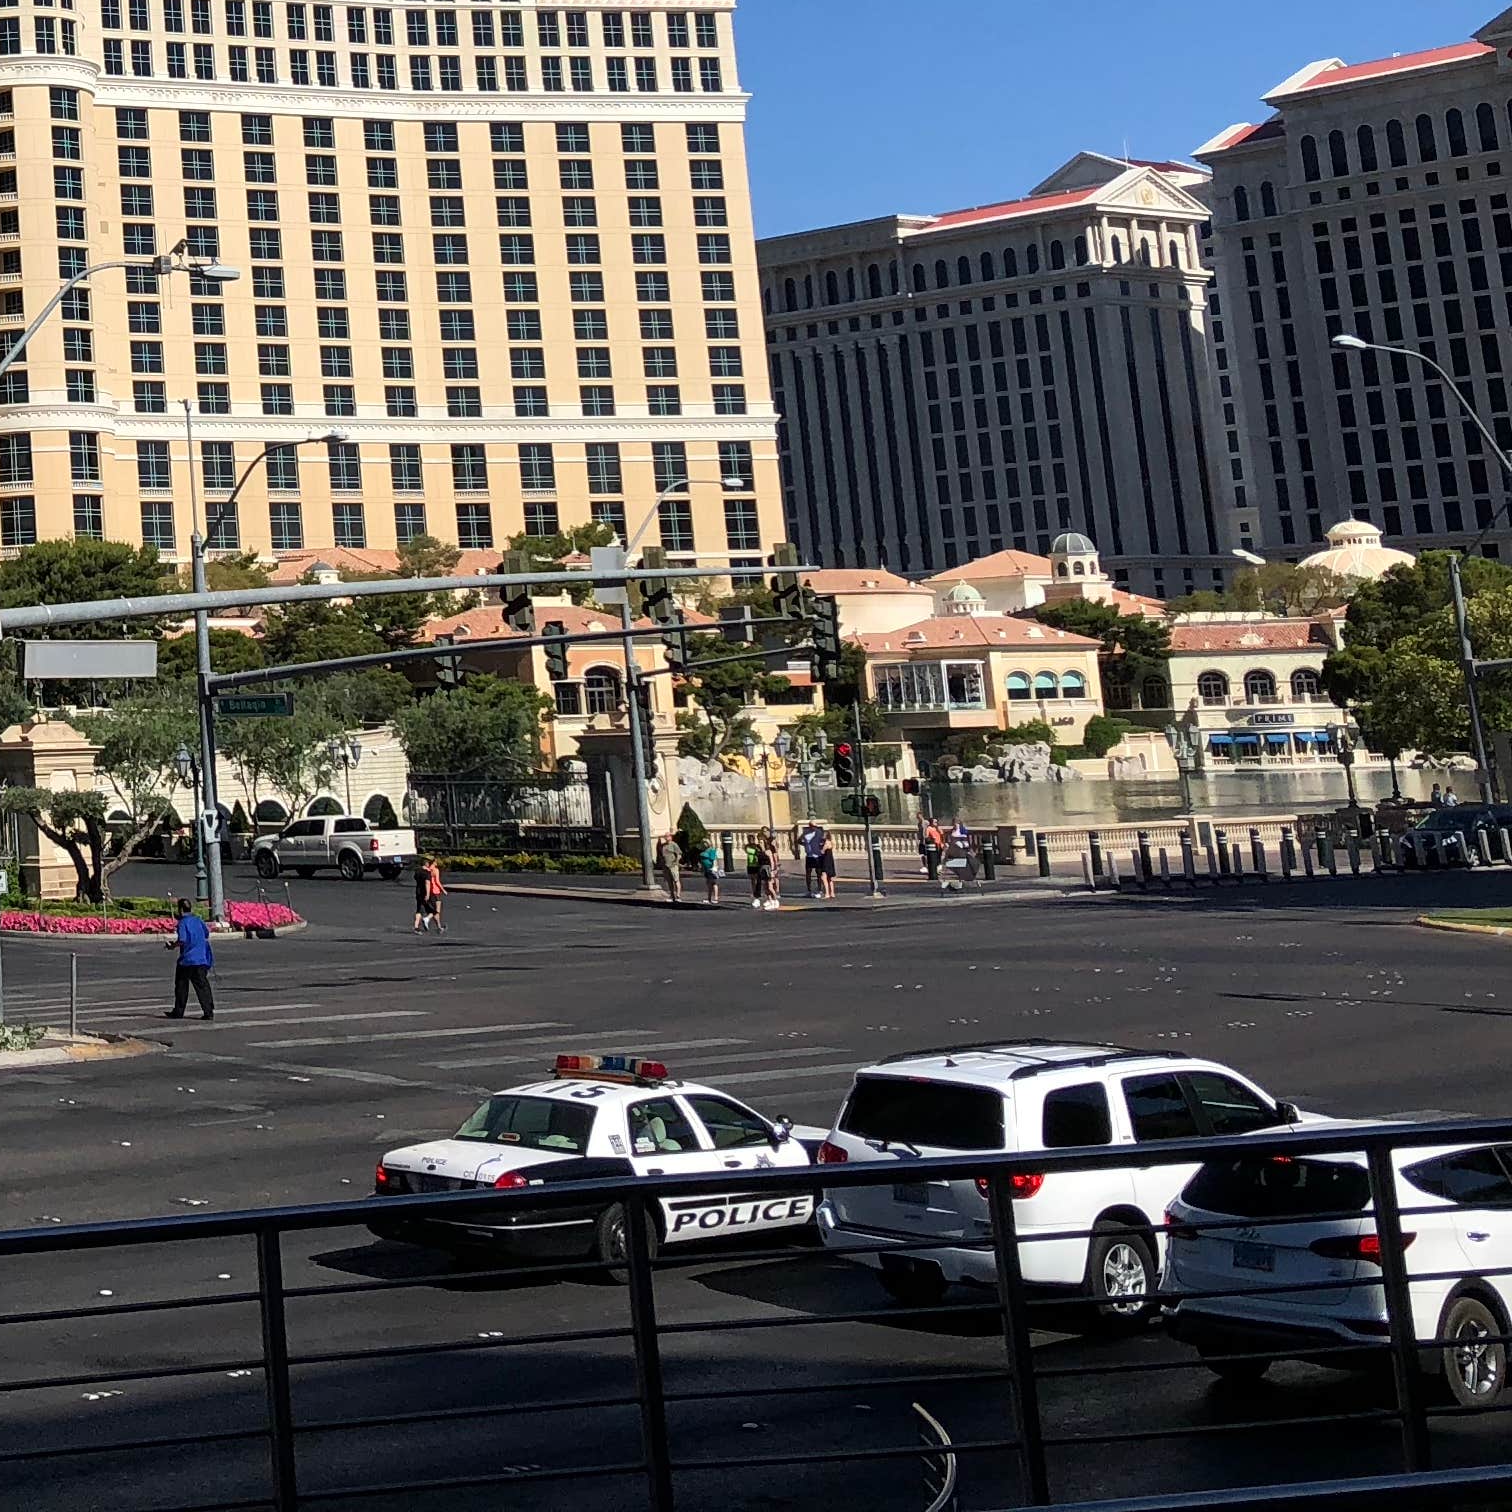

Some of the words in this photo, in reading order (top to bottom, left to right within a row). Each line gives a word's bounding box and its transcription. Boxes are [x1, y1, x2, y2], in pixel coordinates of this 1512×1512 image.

[1257, 714, 1293, 723] PRIME
[421, 1156, 448, 1166] POLICE
[671, 1197, 809, 1233] POLICE
